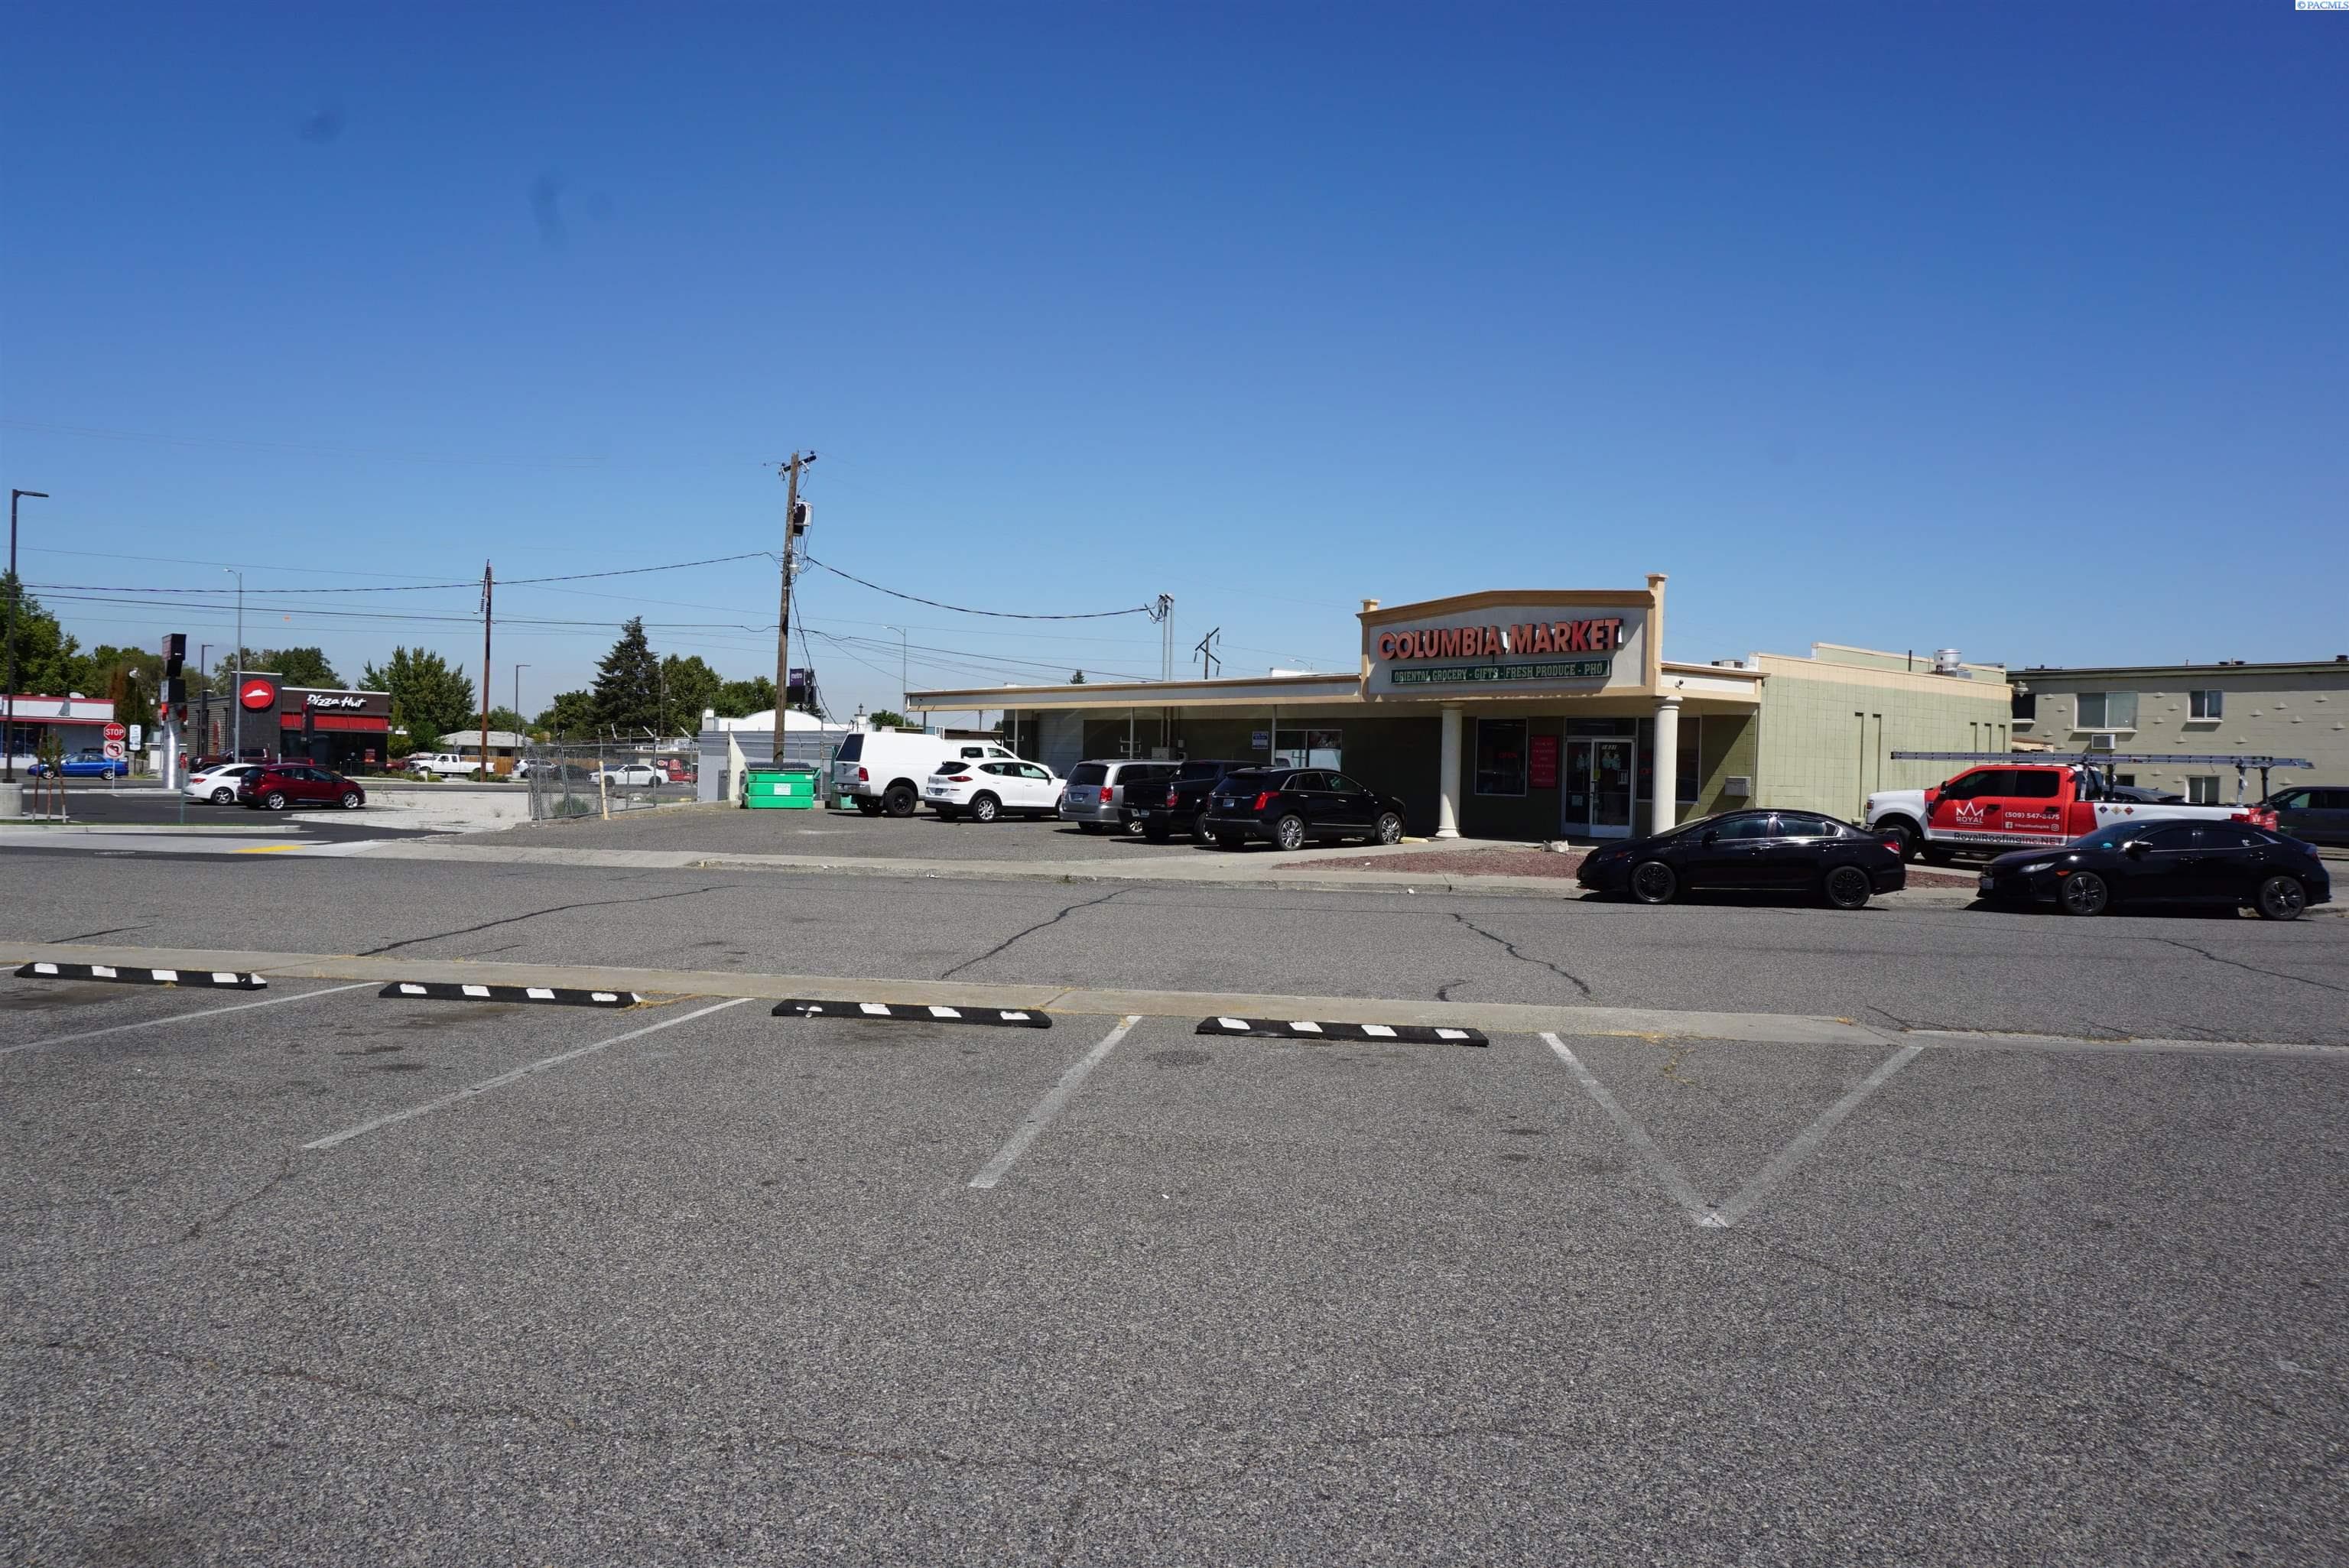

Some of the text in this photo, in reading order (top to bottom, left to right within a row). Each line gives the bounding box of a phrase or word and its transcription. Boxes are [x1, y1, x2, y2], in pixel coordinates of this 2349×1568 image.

[1378, 618, 1621, 661] COLUMBIA MARKET
[1394, 670, 1431, 682] ORIENTAL
[1432, 668, 1467, 681] GROCERY
[1474, 667, 1499, 679] GIFTS
[1506, 665, 1532, 678] FRESH
[1535, 664, 1576, 677] PRODUCE
[307, 694, 367, 708] Pizza Hut
[105, 728, 124, 736] STOP
[1956, 816, 1984, 824] ROYAL
